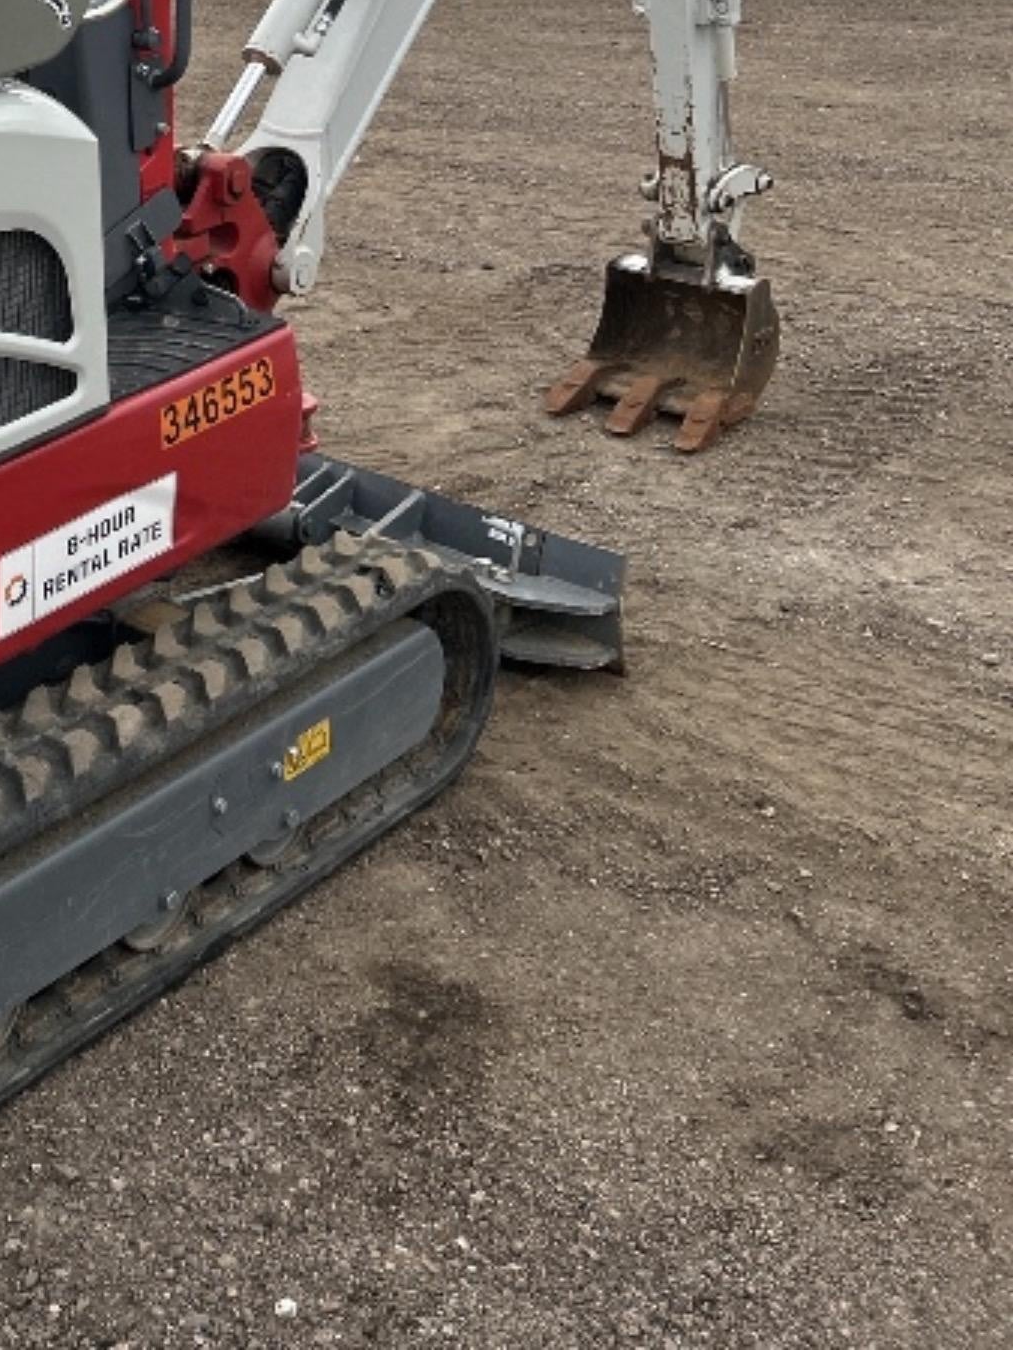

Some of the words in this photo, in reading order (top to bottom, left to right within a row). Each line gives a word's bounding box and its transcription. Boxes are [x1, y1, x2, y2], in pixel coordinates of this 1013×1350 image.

[163, 358, 274, 446] 346553
[43, 548, 112, 601] RENTAL
[117, 520, 163, 559] RATE
